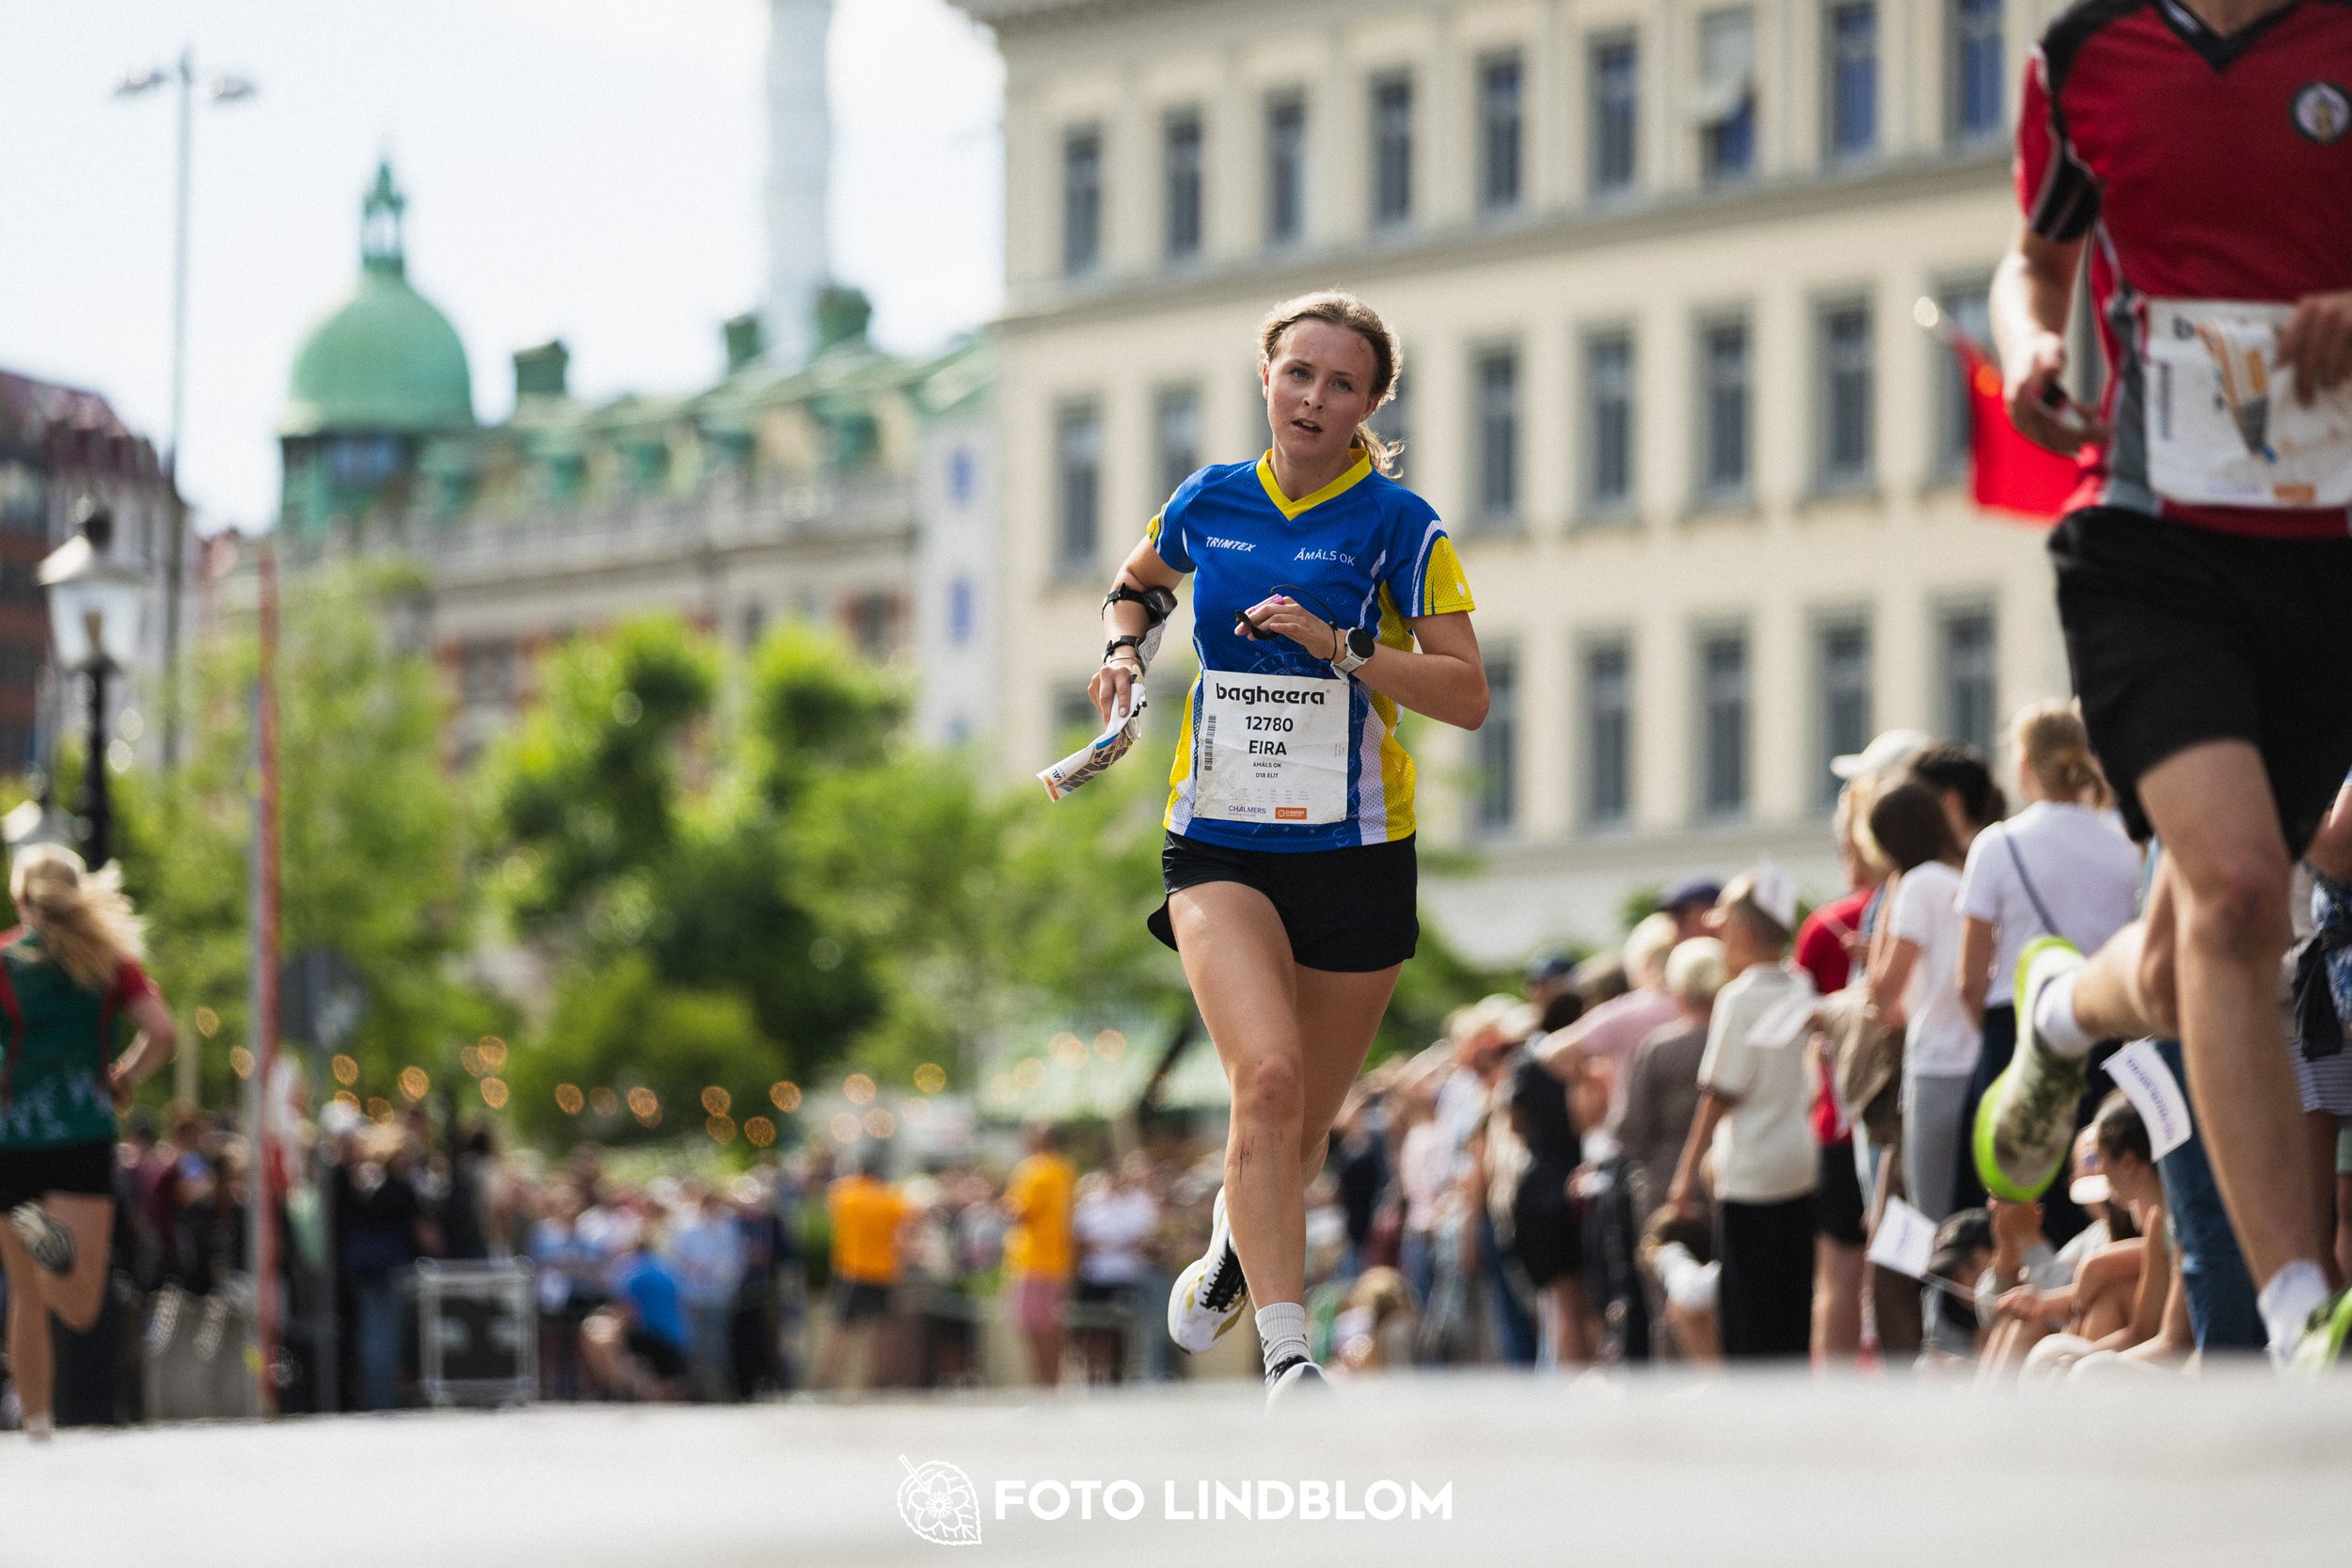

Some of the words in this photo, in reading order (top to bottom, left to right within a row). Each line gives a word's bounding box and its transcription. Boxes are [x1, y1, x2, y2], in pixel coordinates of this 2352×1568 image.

[1206, 536, 1257, 552] TRIMTEX
[1294, 546, 1337, 562] ÅMÅLS
[1339, 553, 1356, 566] OK
[1216, 683, 1325, 705] bagheera
[1245, 716, 1294, 732] 12780
[1248, 739, 1287, 755] EIRA
[1229, 805, 1266, 815] CHALMERS
